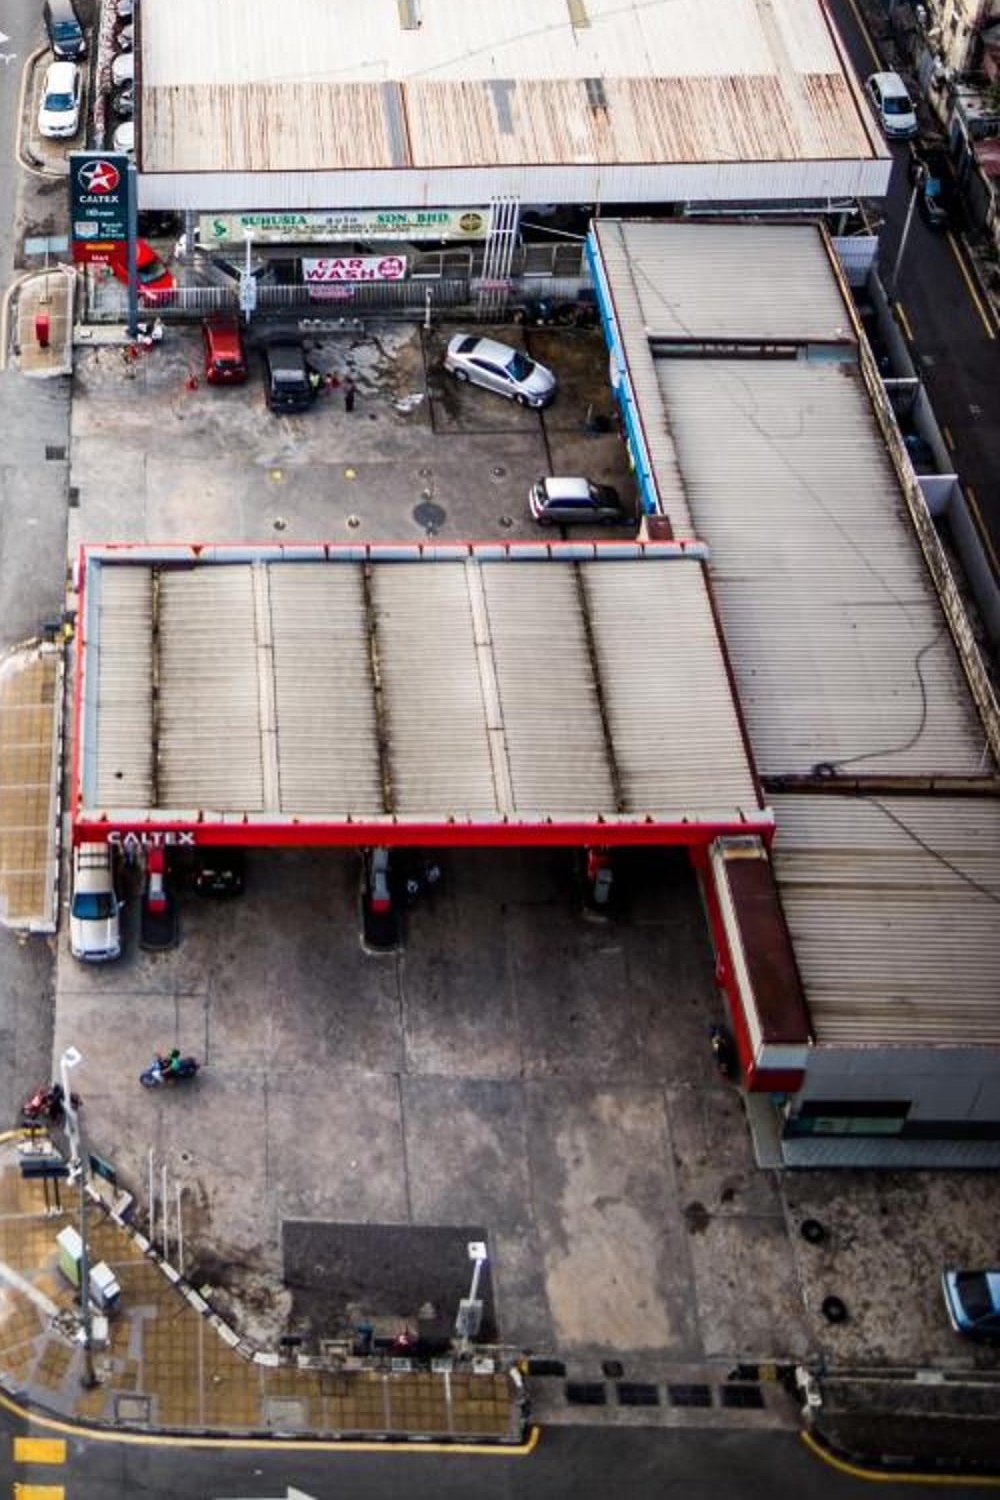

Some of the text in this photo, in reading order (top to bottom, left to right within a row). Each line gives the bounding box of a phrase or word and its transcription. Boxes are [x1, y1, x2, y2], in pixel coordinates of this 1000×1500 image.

[79, 195, 119, 203] CALTEX
[241, 215, 308, 226] SUHUSIA
[317, 259, 363, 269] CAR
[306, 269, 375, 279] WASH
[107, 831, 195, 845] CALTEX
